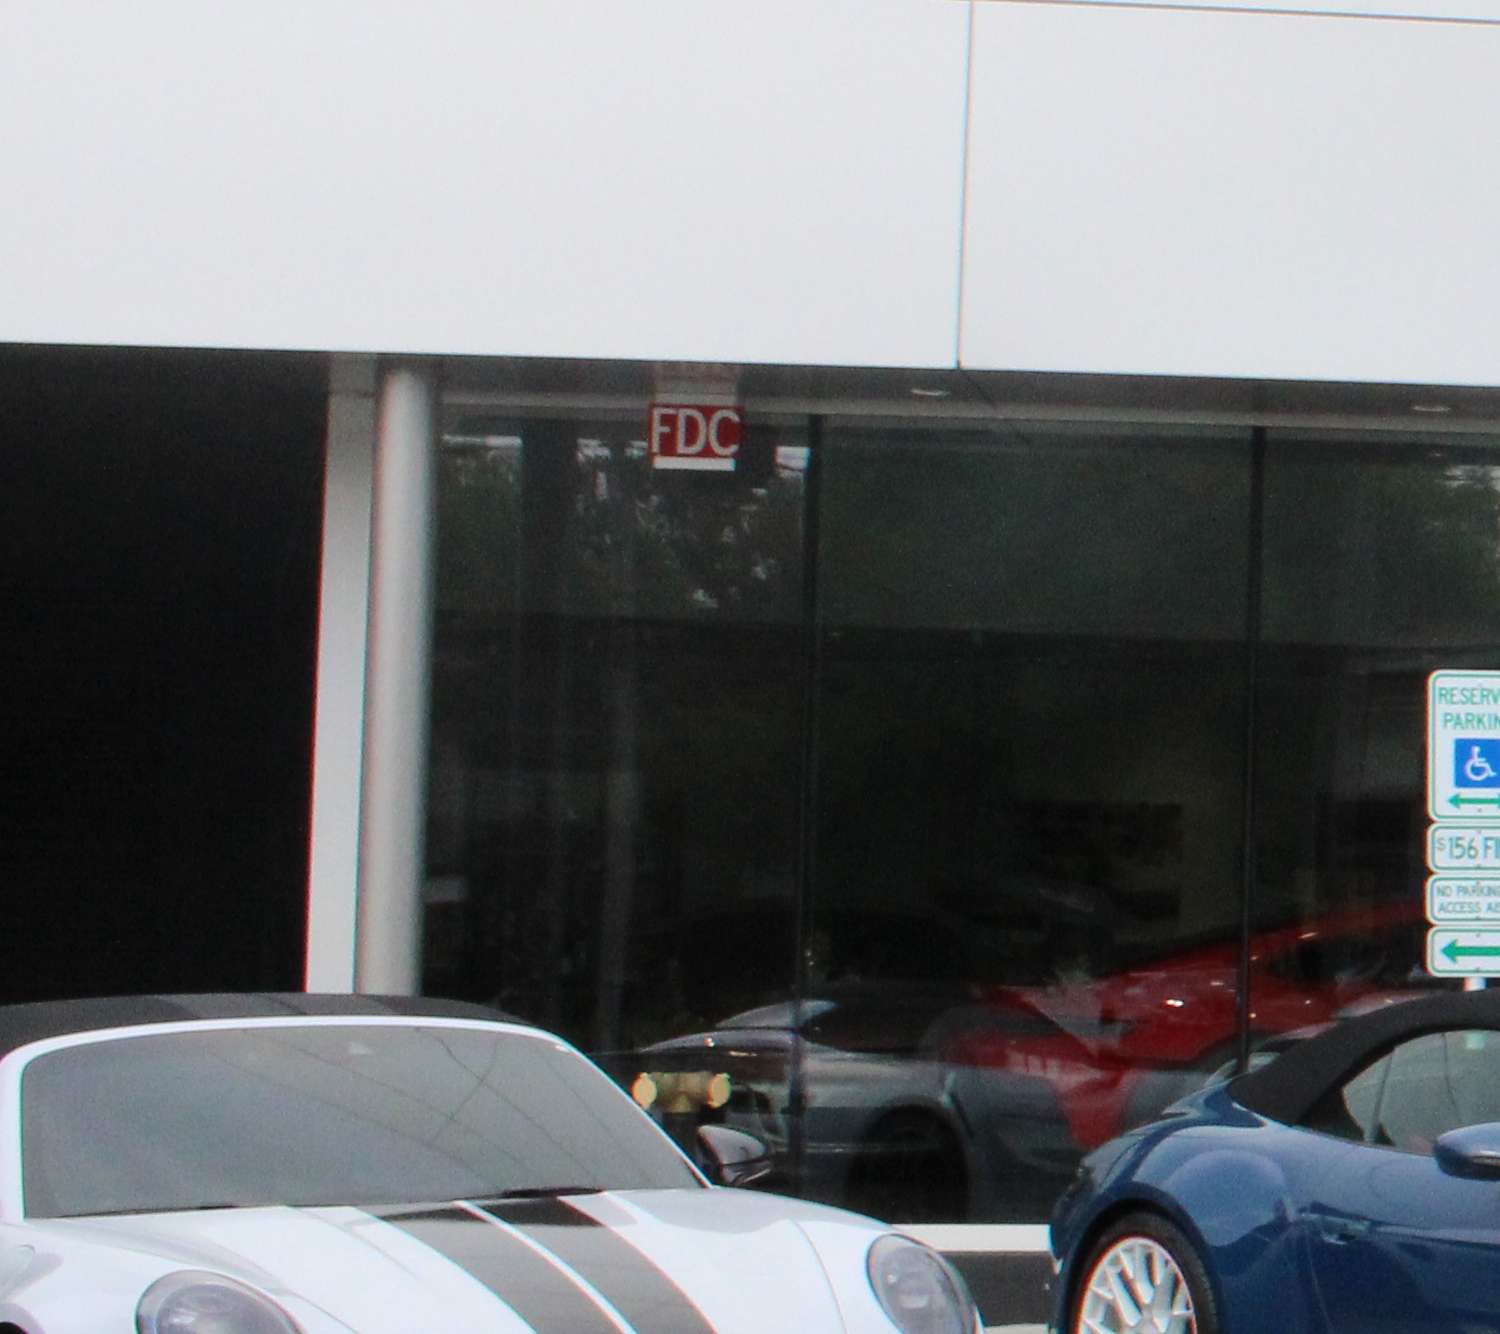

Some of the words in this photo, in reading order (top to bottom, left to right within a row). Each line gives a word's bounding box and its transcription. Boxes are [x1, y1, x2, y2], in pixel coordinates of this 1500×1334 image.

[651, 407, 741, 456] FDC
[1436, 885, 1452, 897] NO
[1437, 901, 1481, 914] ACCESS
